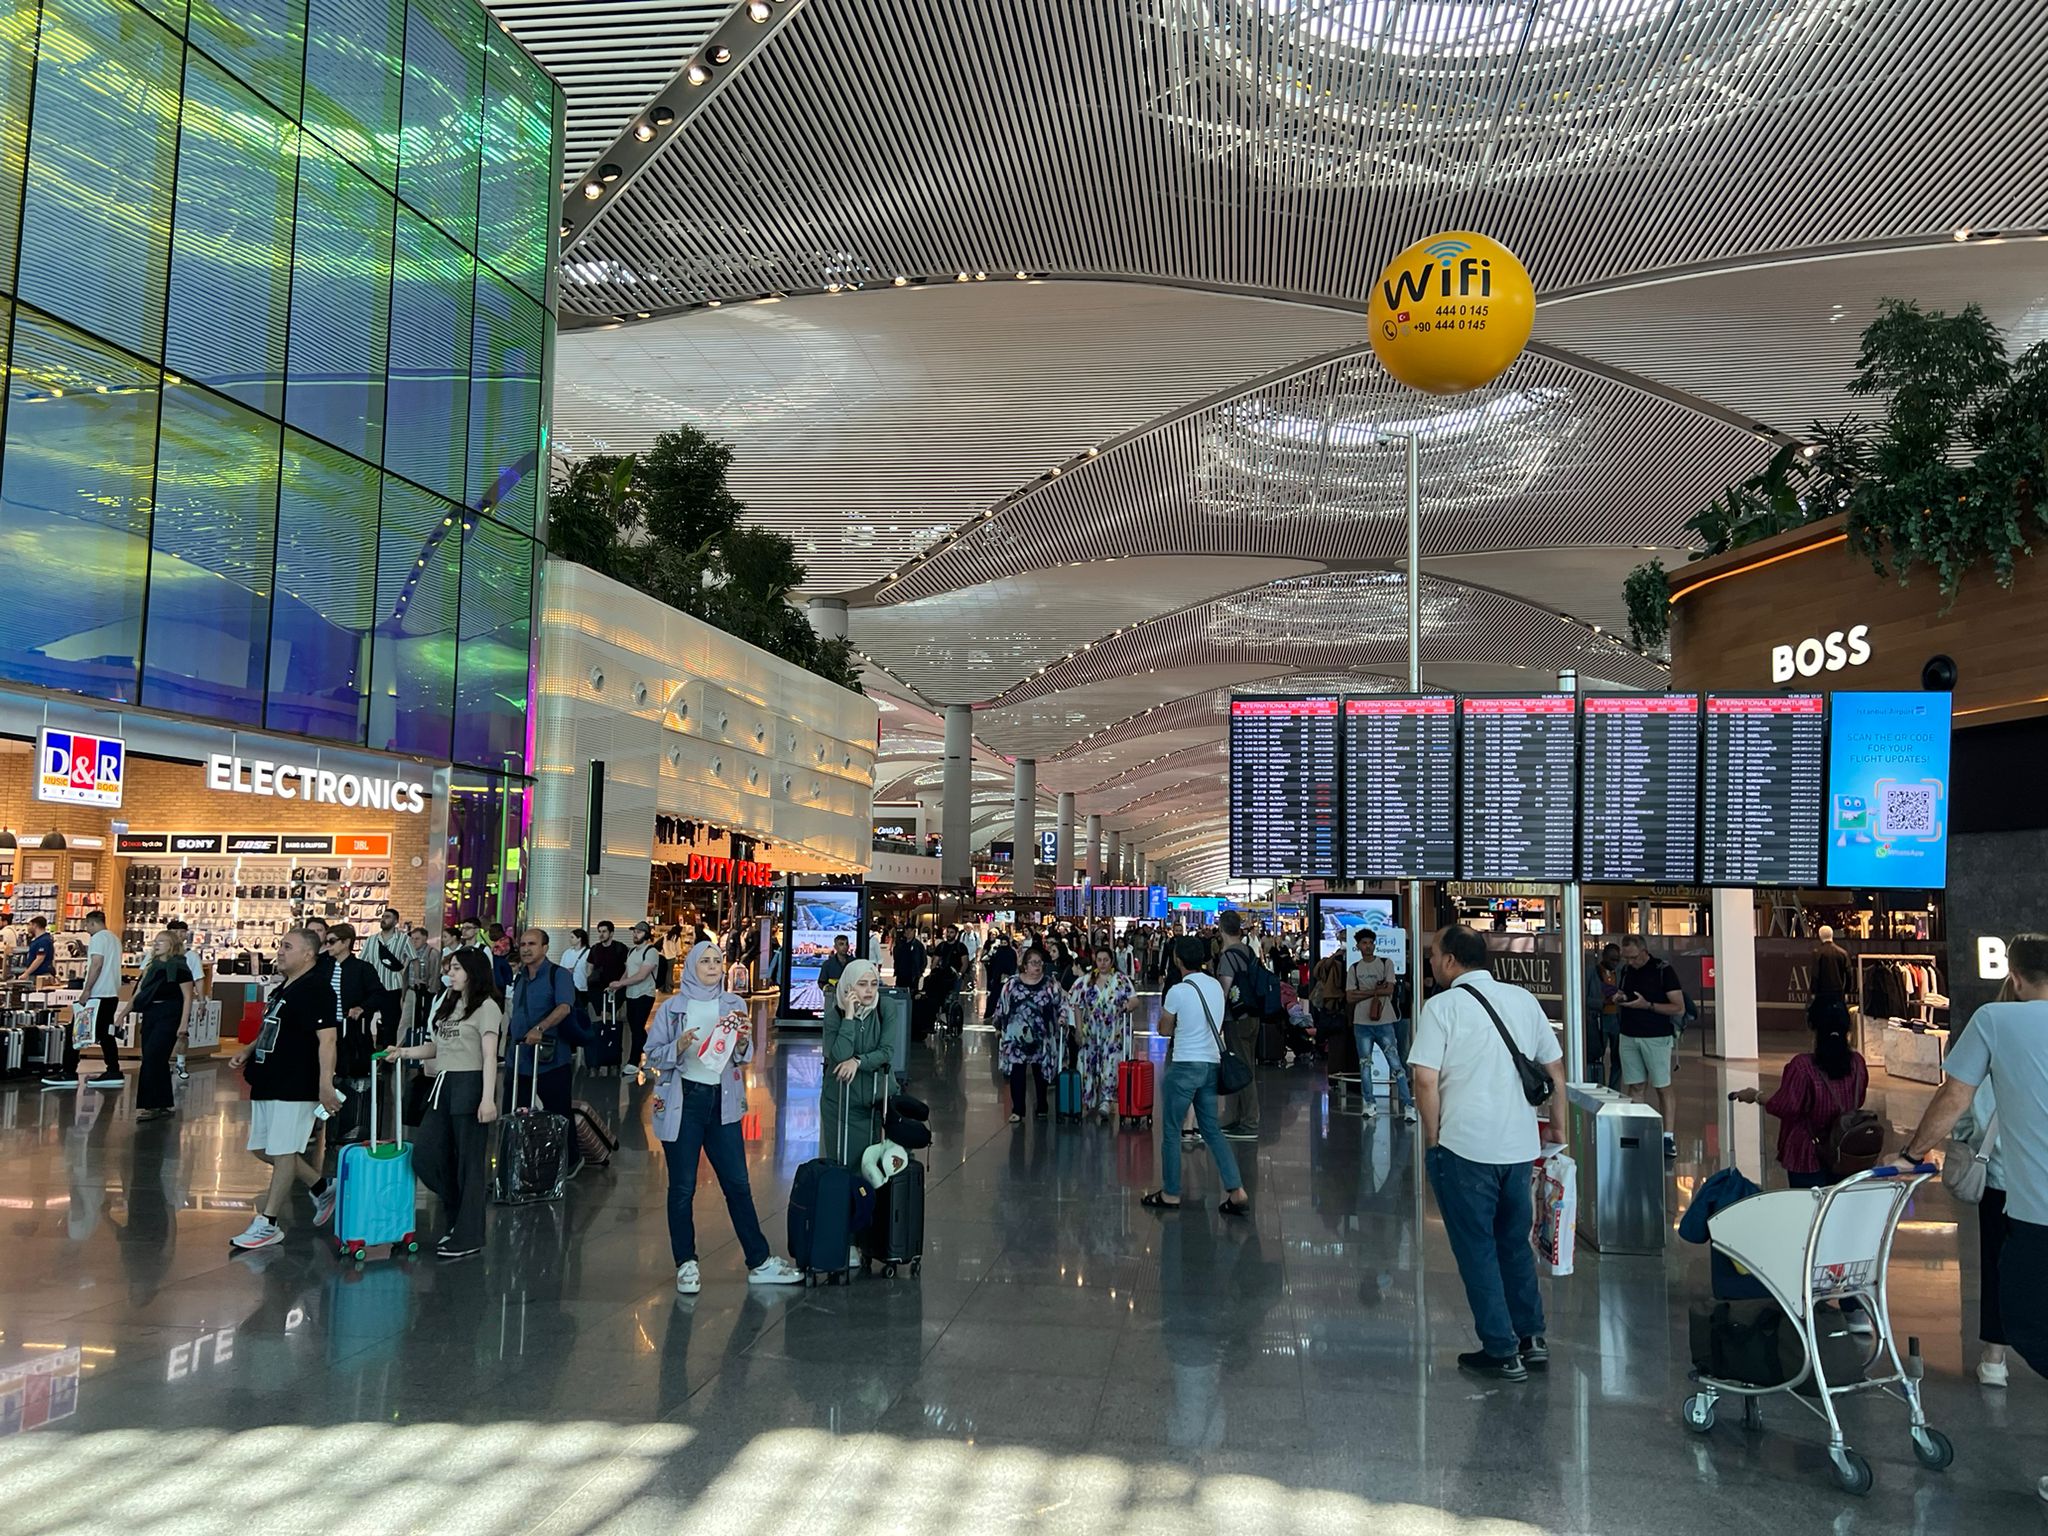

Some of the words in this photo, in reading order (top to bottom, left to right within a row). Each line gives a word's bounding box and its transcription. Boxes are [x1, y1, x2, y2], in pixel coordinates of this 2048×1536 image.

[1384, 258, 1490, 310] Wifi
[1436, 306, 1456, 316] 444
[1460, 306, 1466, 316] 0
[1470, 305, 1488, 316] 145
[1414, 322, 1430, 332] +90
[1435, 320, 1454, 330] 444
[1459, 320, 1465, 329] 0
[1468, 320, 1486, 330] 145
[1772, 624, 1871, 683] BOSS
[44, 746, 120, 784] D&R
[44, 776, 68, 786] MUSIC
[96, 782, 119, 792] BOOK
[208, 754, 424, 814] ELECTRONICS
[177, 839, 215, 849] SONY
[228, 841, 276, 849] BOSE
[354, 840, 368, 850] JBL
[1045, 832, 1055, 845] D
[689, 854, 734, 883] DUTY
[738, 860, 773, 887] FREE
[1493, 958, 1551, 983] AVENUE
